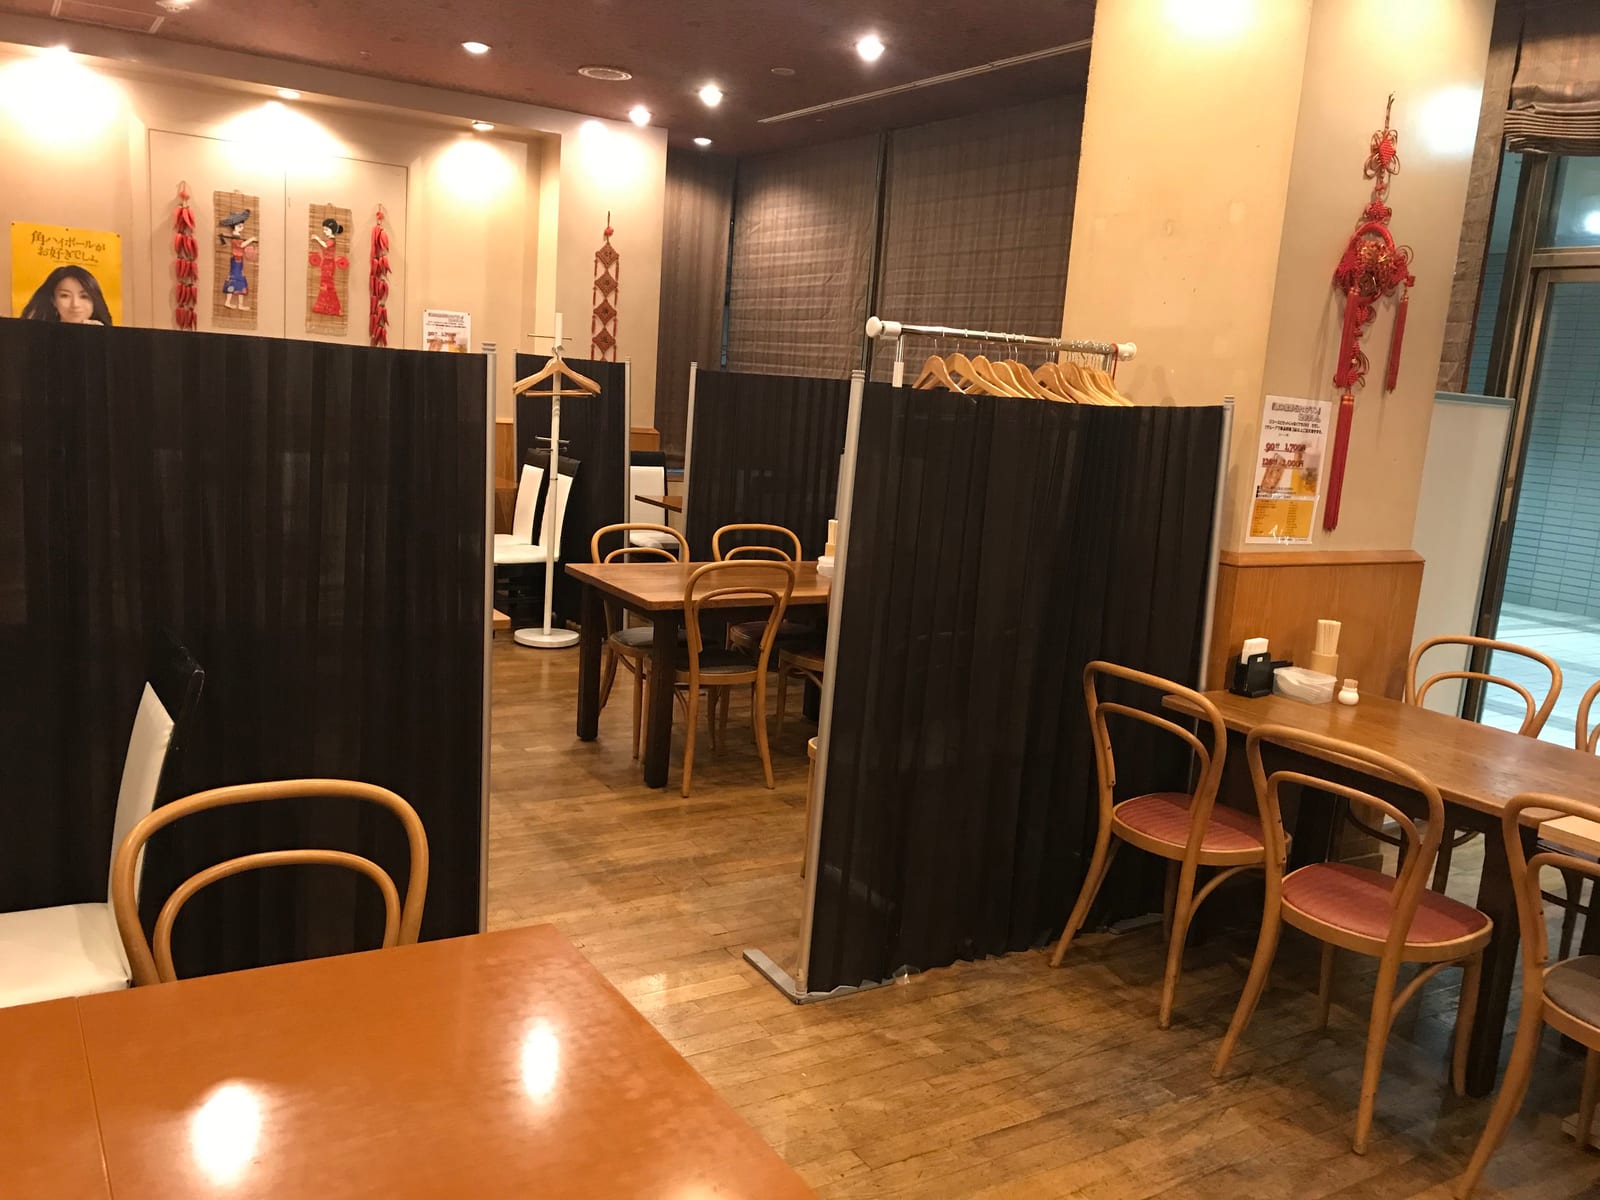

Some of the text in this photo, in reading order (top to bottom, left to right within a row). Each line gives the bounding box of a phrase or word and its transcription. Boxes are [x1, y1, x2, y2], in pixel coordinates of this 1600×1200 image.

[31, 230, 106, 252] 角ハイボールが
